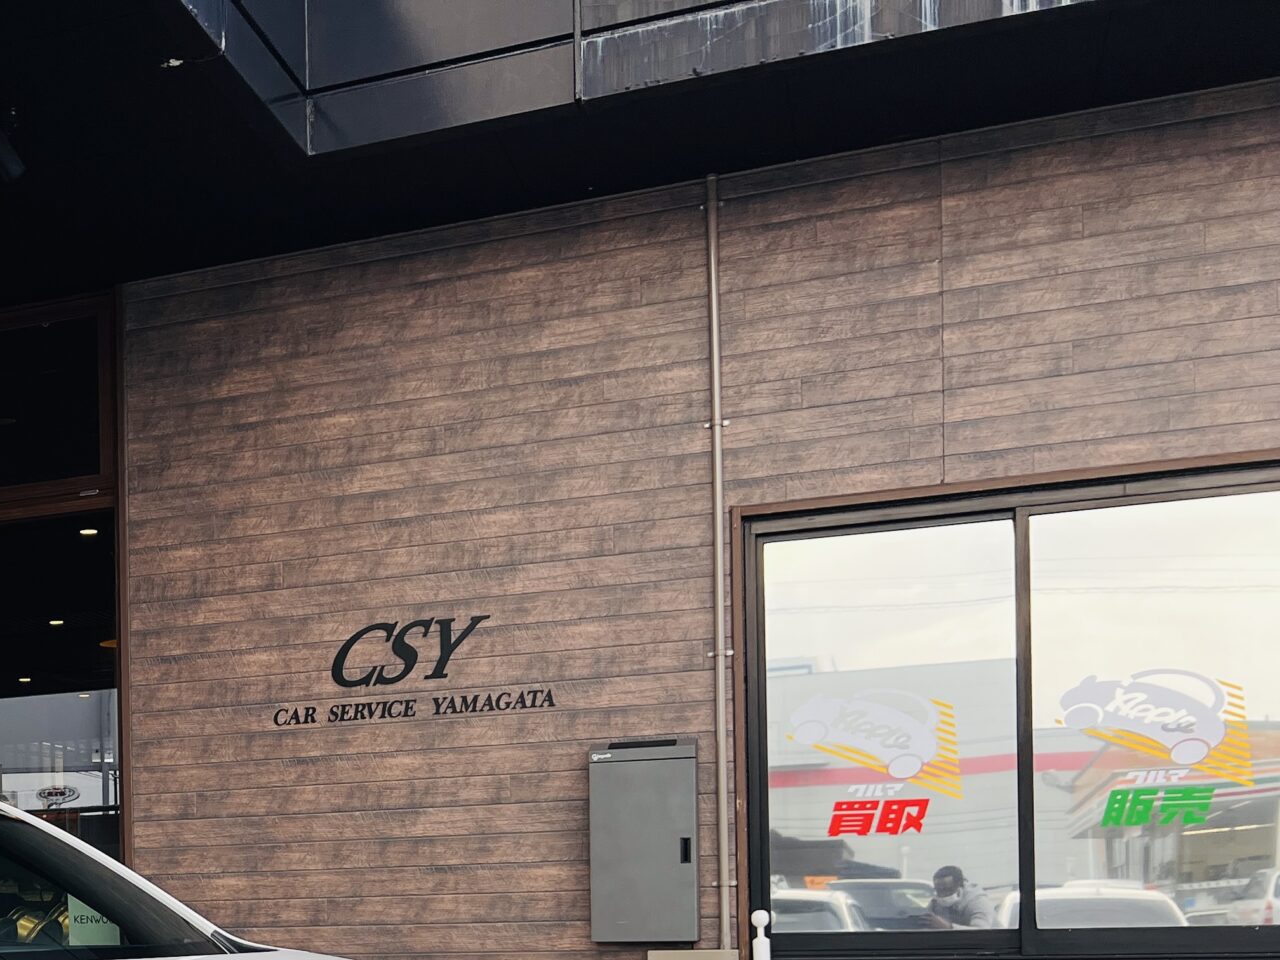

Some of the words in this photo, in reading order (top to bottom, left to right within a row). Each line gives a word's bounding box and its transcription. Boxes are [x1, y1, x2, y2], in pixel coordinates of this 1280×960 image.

[331, 615, 490, 687] CSY
[273, 706, 317, 726] CAR
[327, 699, 417, 723] SERVICE
[432, 689, 556, 716] YAMAGATA
[1104, 688, 1197, 733] Apple
[847, 783, 904, 797] クルマ
[1125, 769, 1190, 785] クルマ
[827, 798, 930, 837] 買取
[1101, 787, 1216, 827] 販売
